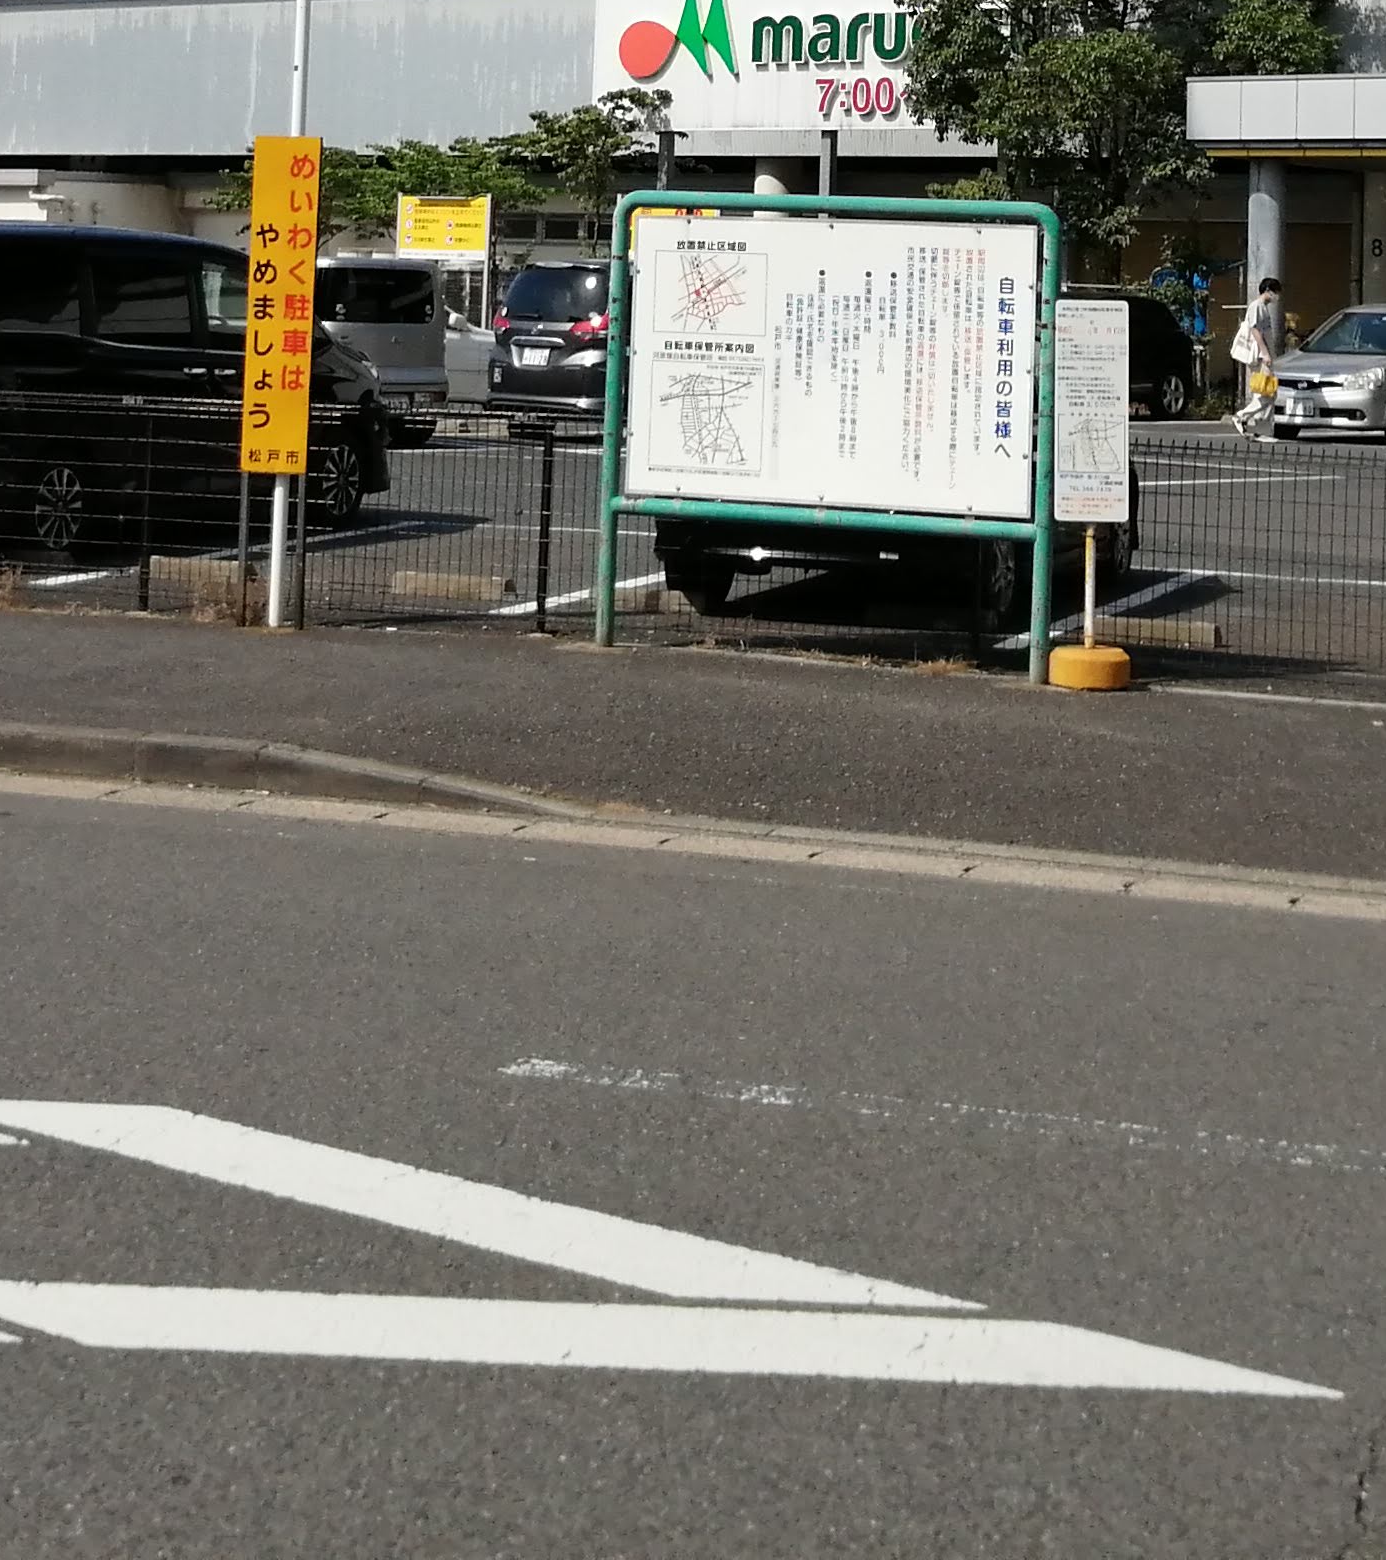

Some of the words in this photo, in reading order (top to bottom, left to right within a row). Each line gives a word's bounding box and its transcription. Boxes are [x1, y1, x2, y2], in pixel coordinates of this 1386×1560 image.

[751, 12, 923, 63] maru
[676, 240, 748, 252] 放置禁止区域図
[1371, 239, 1383, 258] 8
[279, 152, 317, 392] めいわく駐車は
[247, 222, 279, 430] やめましょう
[664, 340, 755, 354] 自転車保管所案内図
[993, 276, 1016, 459] 自転車利用の皆様へ
[248, 448, 300, 466] 松戸市
